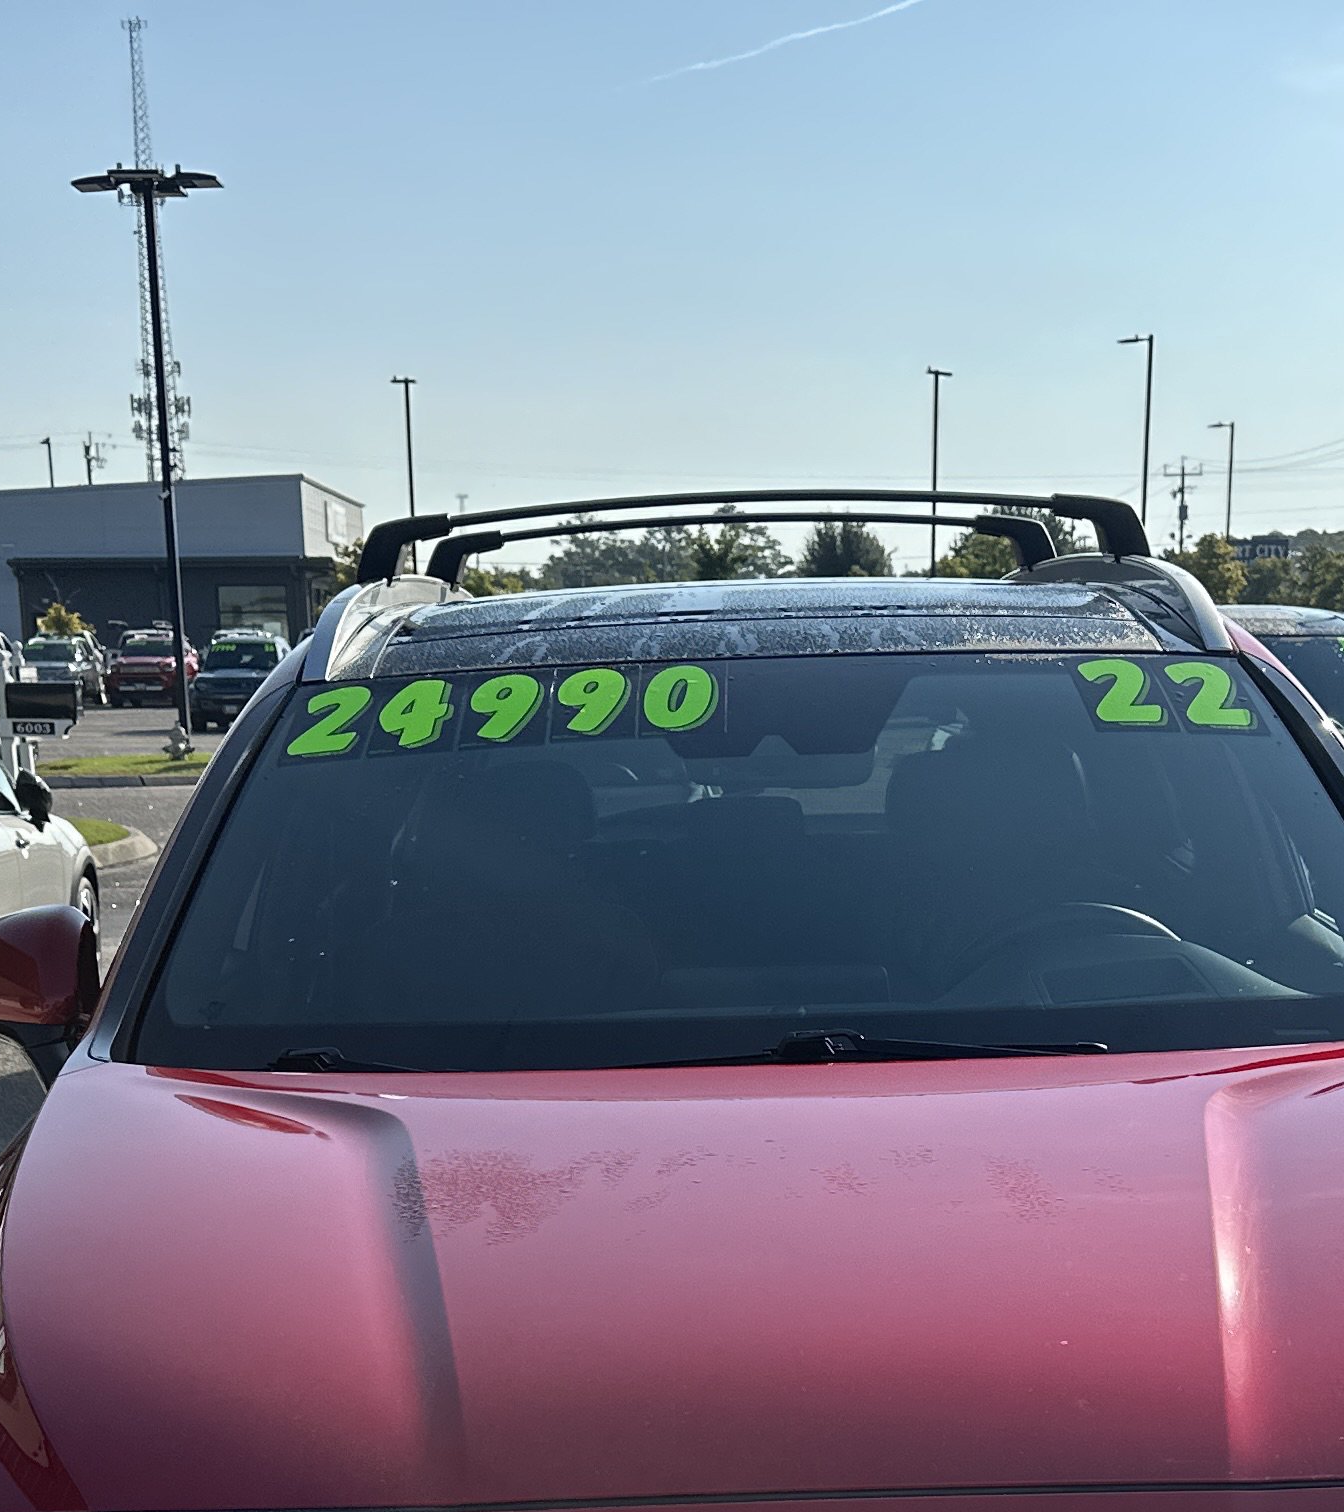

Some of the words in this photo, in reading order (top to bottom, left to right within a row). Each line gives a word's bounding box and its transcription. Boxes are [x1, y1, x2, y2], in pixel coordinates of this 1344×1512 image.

[16, 722, 51, 734] 6003
[286, 663, 721, 758] 24990
[1076, 657, 1254, 728] 22
